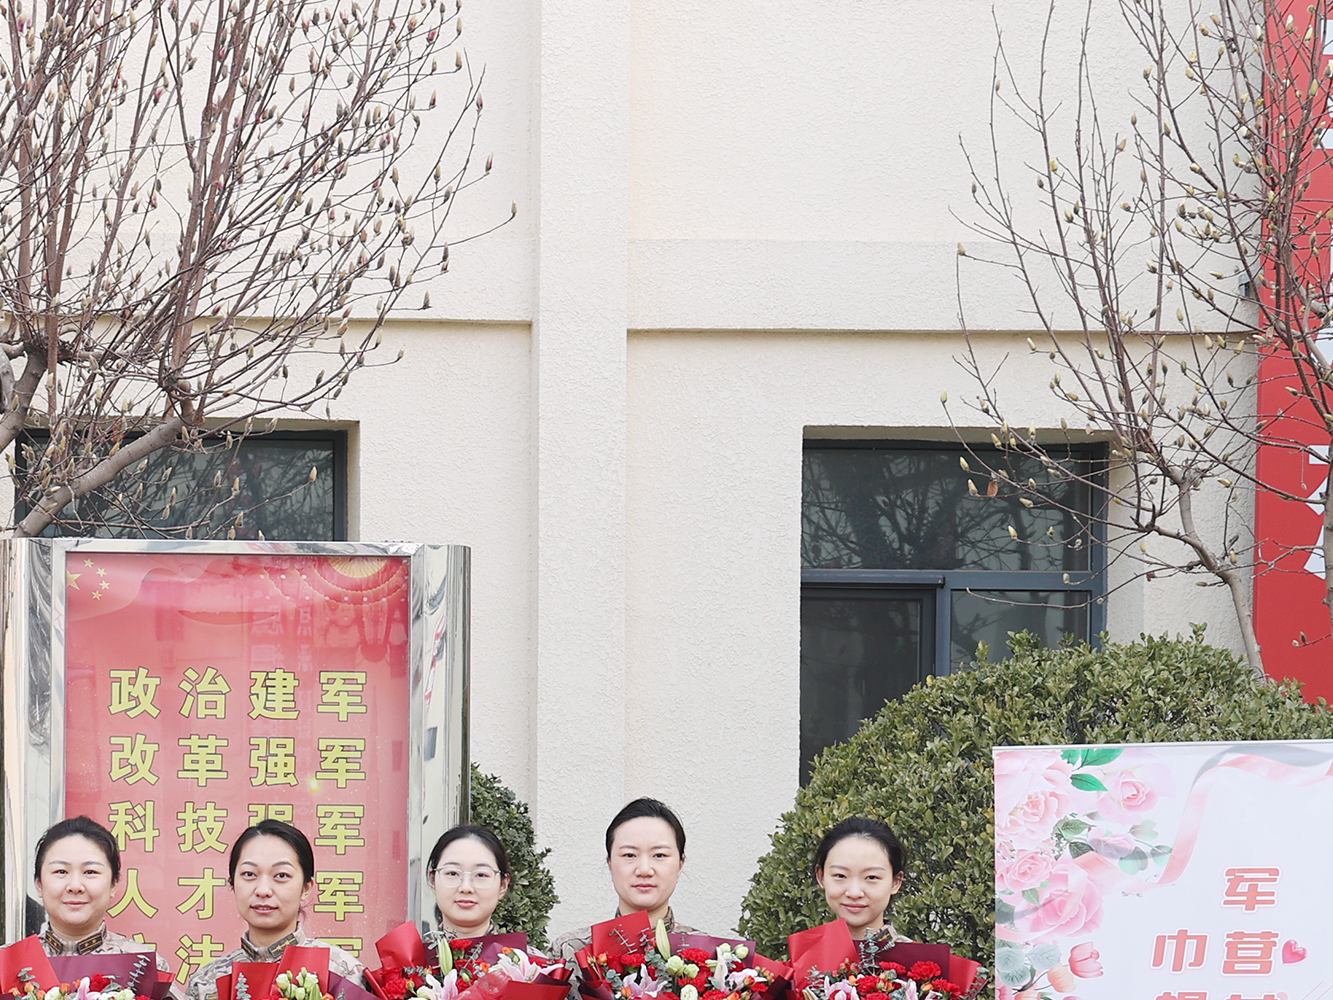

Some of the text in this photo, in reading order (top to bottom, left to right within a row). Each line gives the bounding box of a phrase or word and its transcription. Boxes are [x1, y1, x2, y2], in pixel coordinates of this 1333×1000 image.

[108, 667, 368, 722] 政治建军
[108, 733, 367, 789] 改革强军
